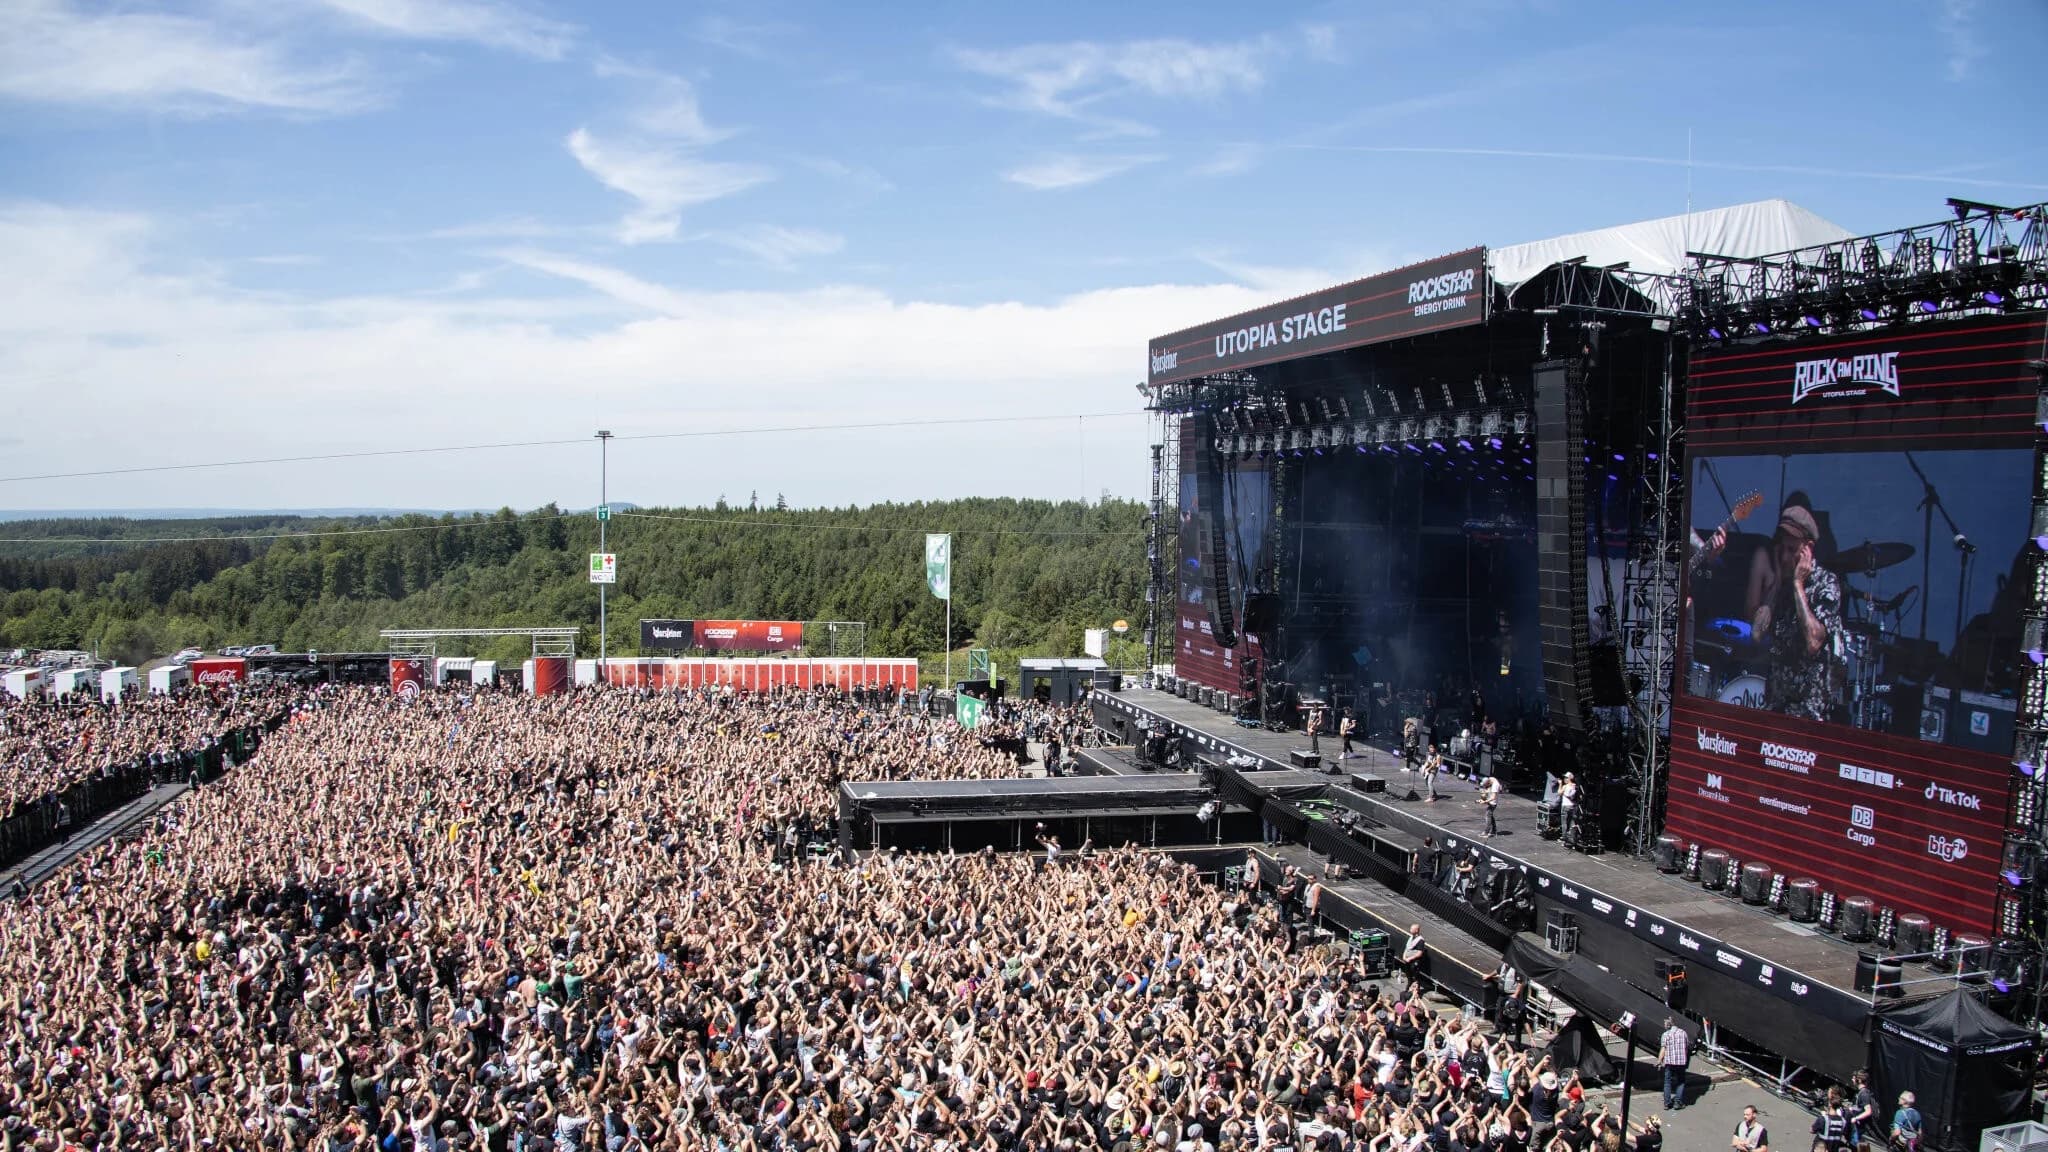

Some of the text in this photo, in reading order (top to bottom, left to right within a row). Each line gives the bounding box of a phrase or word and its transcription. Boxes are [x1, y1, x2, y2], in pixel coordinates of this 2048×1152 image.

[1408, 269, 1474, 303] ROCKSTAR
[1414, 295, 1466, 317] ENERGY DRINK
[1215, 303, 1347, 358] UTOPIA STAGE
[1792, 358, 1838, 404] ROCK
[1852, 351, 1900, 397] RING
[1697, 726, 1738, 756] Warsteiner
[1760, 742, 1817, 766] ROCKSTAR
[1765, 757, 1809, 774] ENERGY DRINK
[1938, 787, 1981, 811] TikTok
[1854, 808, 1872, 826] DB
[1847, 828, 1876, 847] Cargo
